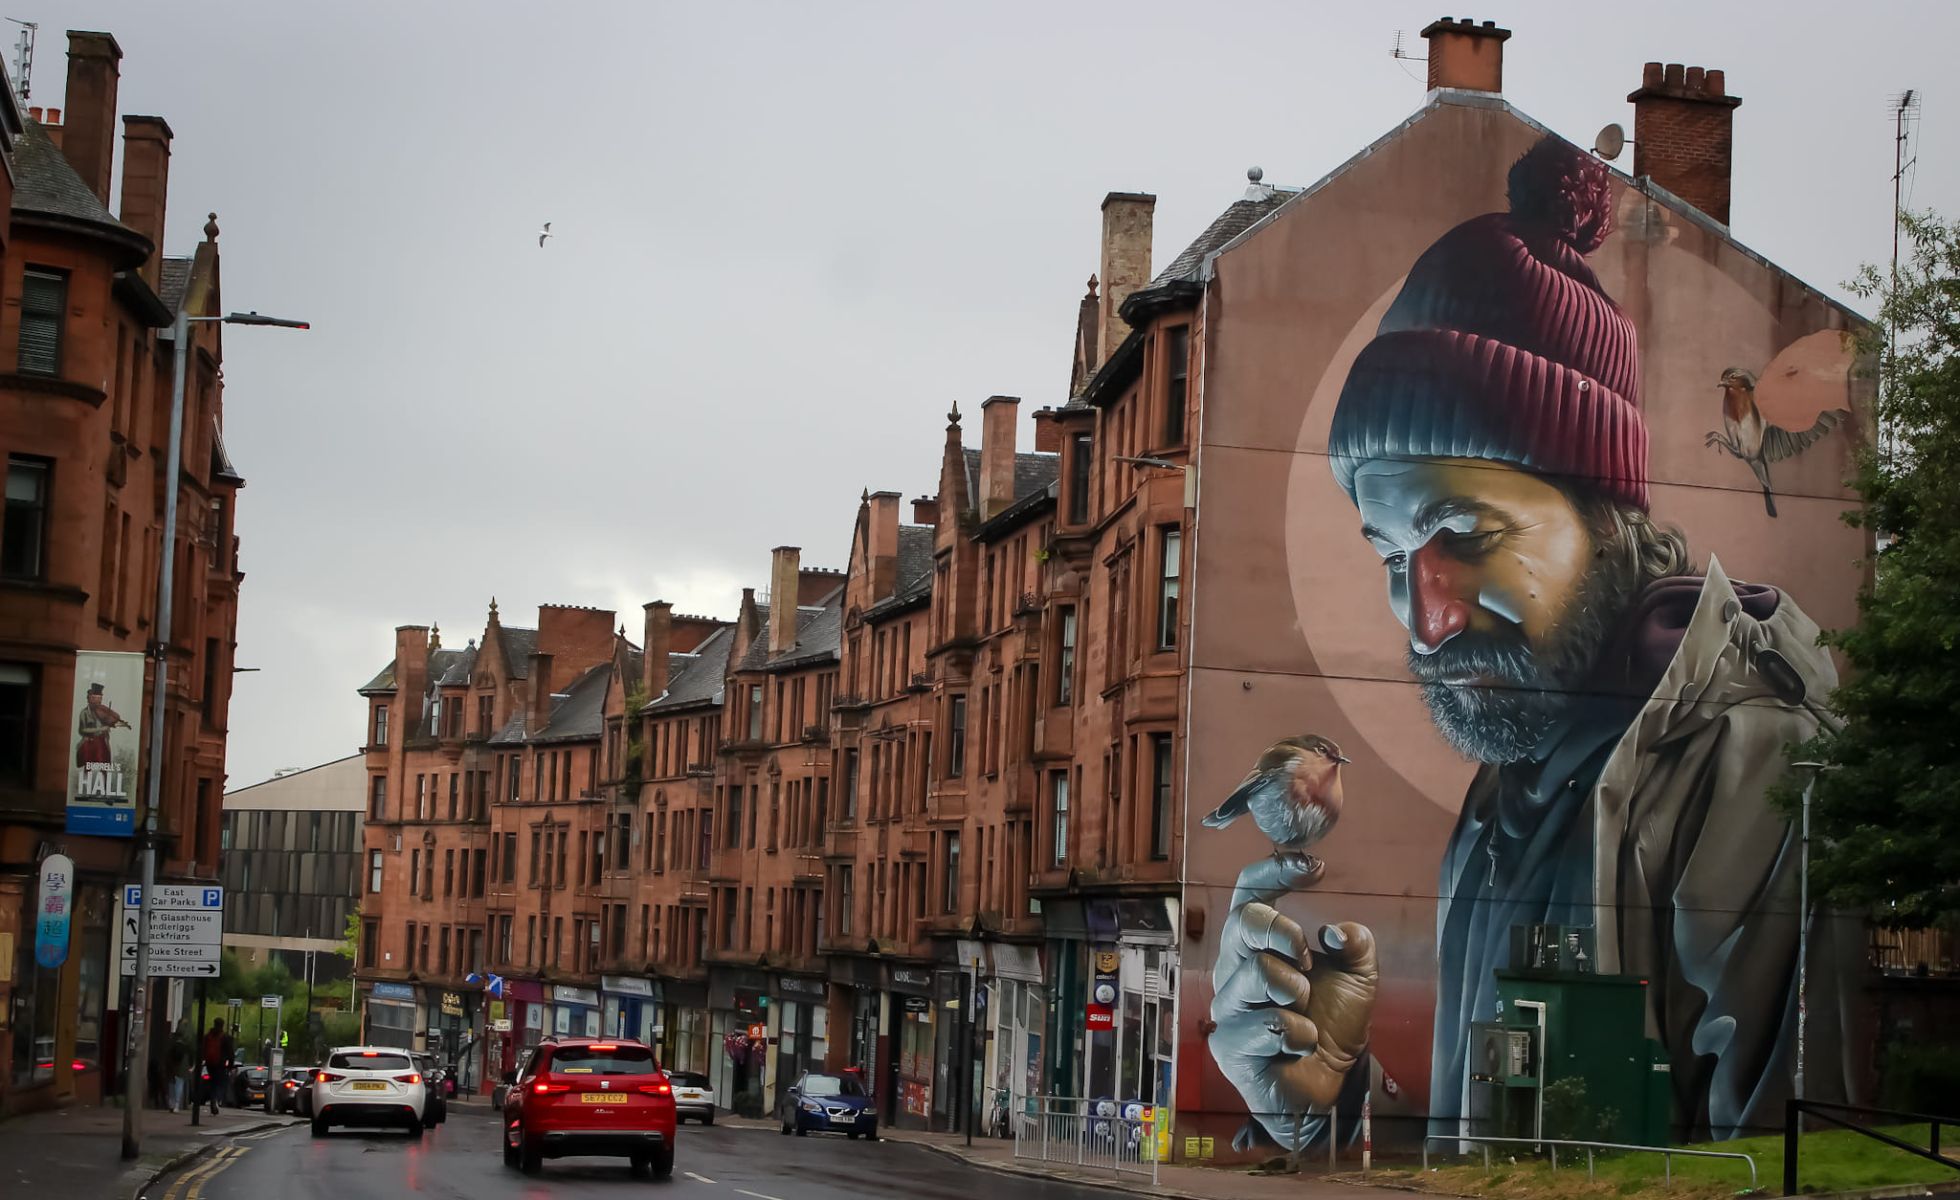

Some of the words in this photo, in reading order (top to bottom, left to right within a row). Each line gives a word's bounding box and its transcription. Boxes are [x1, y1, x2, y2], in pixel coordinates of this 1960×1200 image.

[86, 761, 122, 771] BURRELL'S
[78, 768, 127, 797] HALL
[164, 888, 184, 896] East
[152, 897, 167, 906] Car
[171, 897, 196, 906] Parks
[207, 891, 218, 906] P
[161, 913, 212, 922] Glasshouse
[149, 932, 191, 940] ackfriars
[148, 947, 171, 956] Duke
[174, 947, 202, 956] Street
[130, 963, 163, 973] Grge
[166, 963, 195, 972] Street
[1089, 1013, 1111, 1022] Sun
